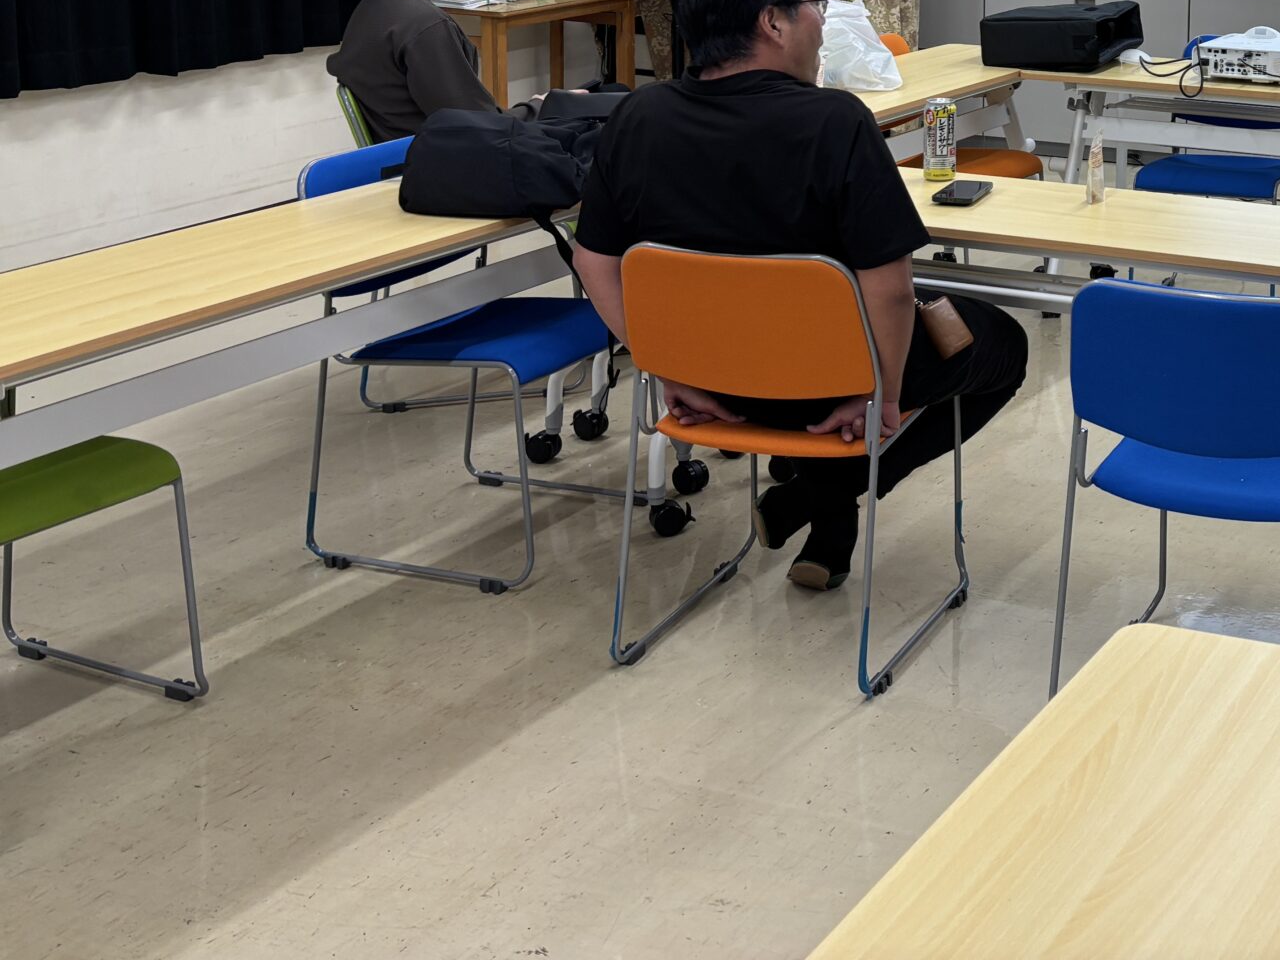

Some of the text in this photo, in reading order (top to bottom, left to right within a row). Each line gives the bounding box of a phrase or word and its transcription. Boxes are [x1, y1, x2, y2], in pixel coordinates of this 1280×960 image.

[938, 119, 946, 154] レモンサワー
